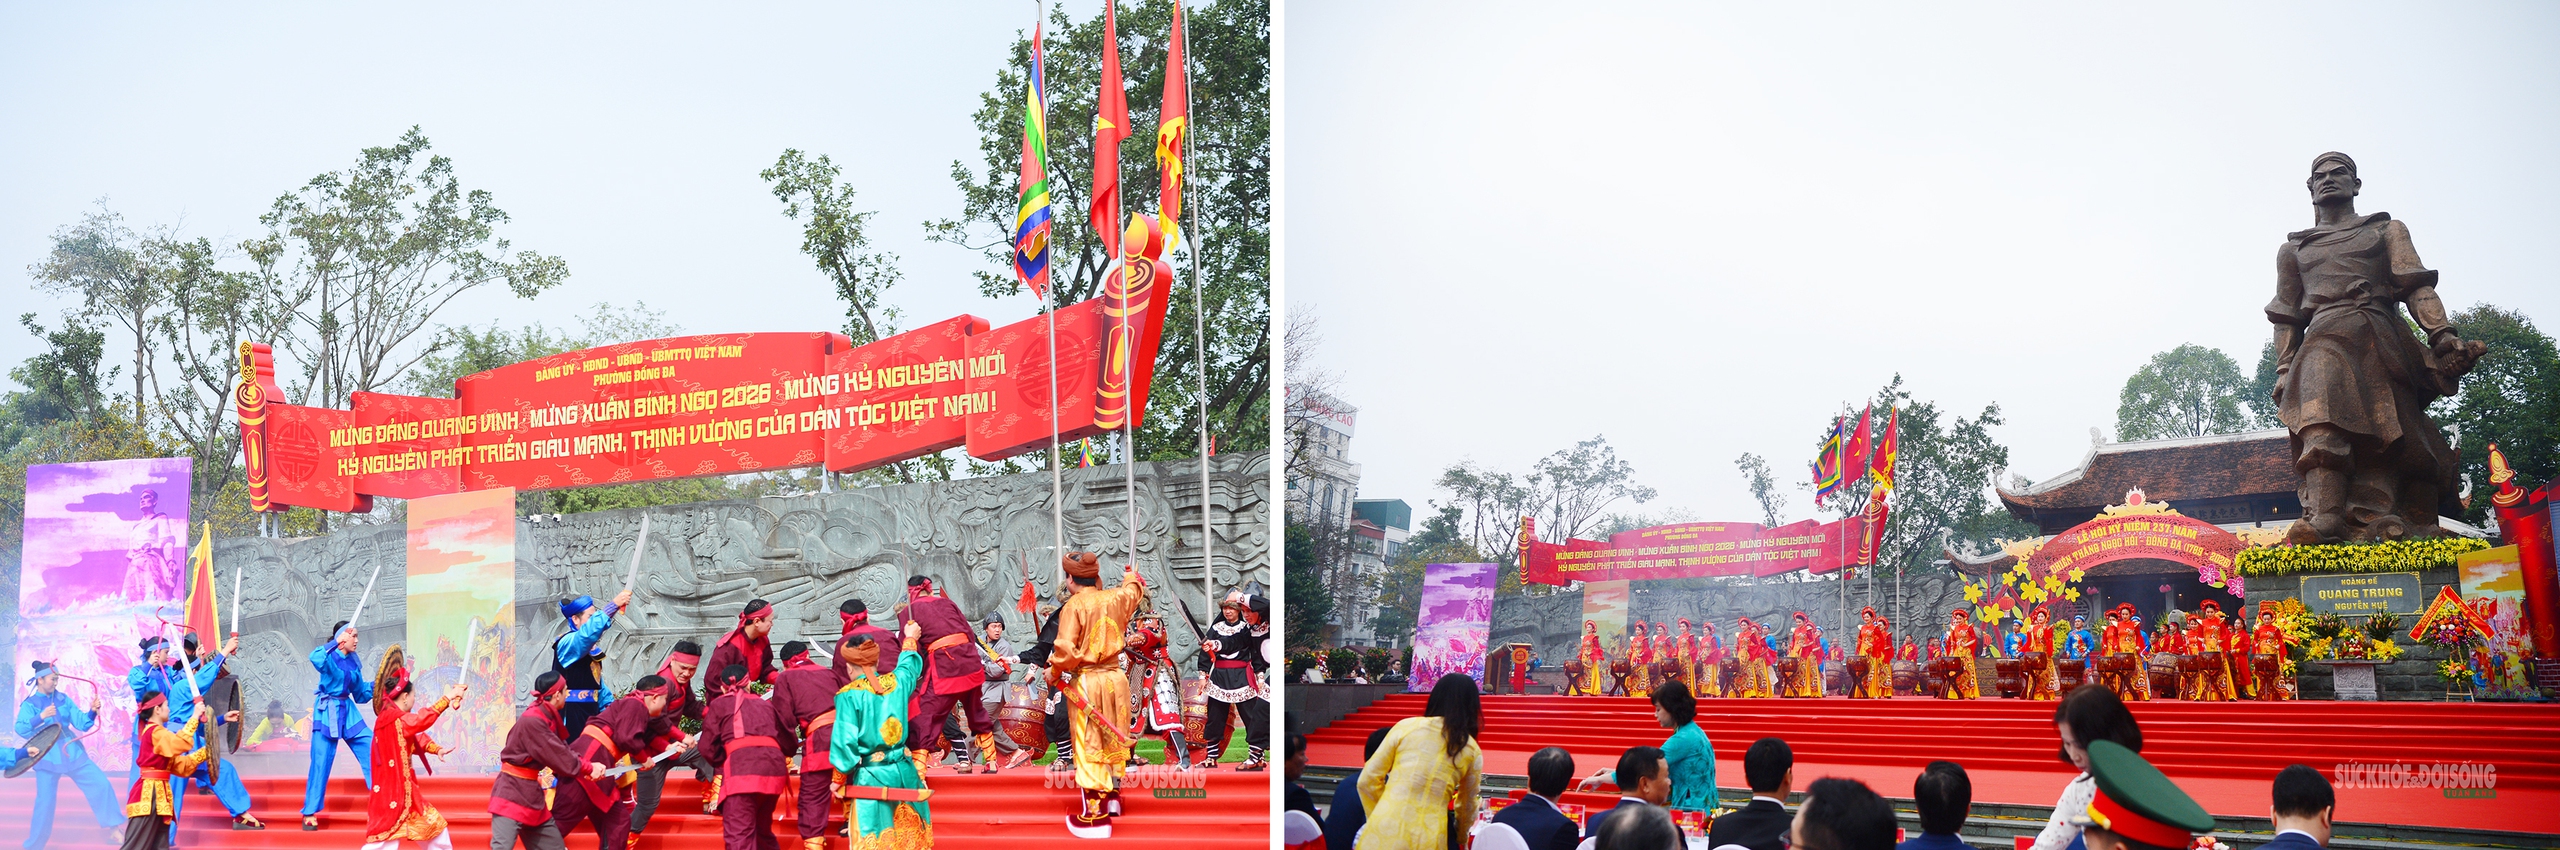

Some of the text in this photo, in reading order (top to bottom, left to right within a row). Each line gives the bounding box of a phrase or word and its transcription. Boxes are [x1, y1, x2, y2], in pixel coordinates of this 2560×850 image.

[535, 367, 562, 383] ĐẢNG
[563, 361, 576, 378] ỦY
[582, 357, 609, 373] HĐND
[616, 353, 644, 368] UBND
[652, 347, 692, 363] UBMTTQ
[694, 344, 717, 360] VIỆT
[718, 345, 743, 359] NAM
[592, 364, 676, 387] PHƯỜNG ĐỐNG ĐA
[329, 422, 373, 448] MỪNG
[376, 417, 419, 445] ĐẢNG
[421, 414, 477, 440] QUANG
[480, 411, 519, 435] VINH
[530, 400, 578, 429] MỪNG
[581, 396, 630, 424] XUÂN
[634, 391, 677, 419] BÍNH
[680, 389, 718, 415] NGỌ
[721, 383, 772, 409] 2026
[784, 370, 840, 401] MỪNG
[844, 363, 873, 393] KỶ
[877, 356, 965, 390] NGUYÊN
[968, 349, 1007, 379] MỚI
[337, 449, 361, 477] KỶ
[362, 448, 429, 475] NGUYÊN
[430, 442, 474, 469] PHÁT
[476, 434, 527, 464] TRIỂN
[530, 432, 570, 461] GIÀU
[573, 431, 628, 460] MẠNH,
[630, 426, 686, 454] THỊNH
[689, 417, 753, 447] VƯỢNG
[756, 408, 796, 438] CỦA
[799, 404, 842, 433] DÂN
[844, 398, 887, 431] TỘC
[889, 394, 939, 426] VIỆT
[2076, 521, 2198, 545] LỄ HỘI KỶ NIỆM 237 NĂM
[2170, 538, 2182, 550] ĐA
[1594, 549, 1617, 558] QUANG
[1618, 548, 1634, 557] VINH
[1715, 541, 1735, 551] 2026
[1776, 534, 1810, 546] NGUYÊN
[1568, 560, 1595, 572] NGUYÊN
[2341, 576, 2366, 586] HOÀNG
[2318, 587, 2403, 601] QUANG TRUNG
[2334, 599, 2389, 611] NGUYỄN HUỆ
